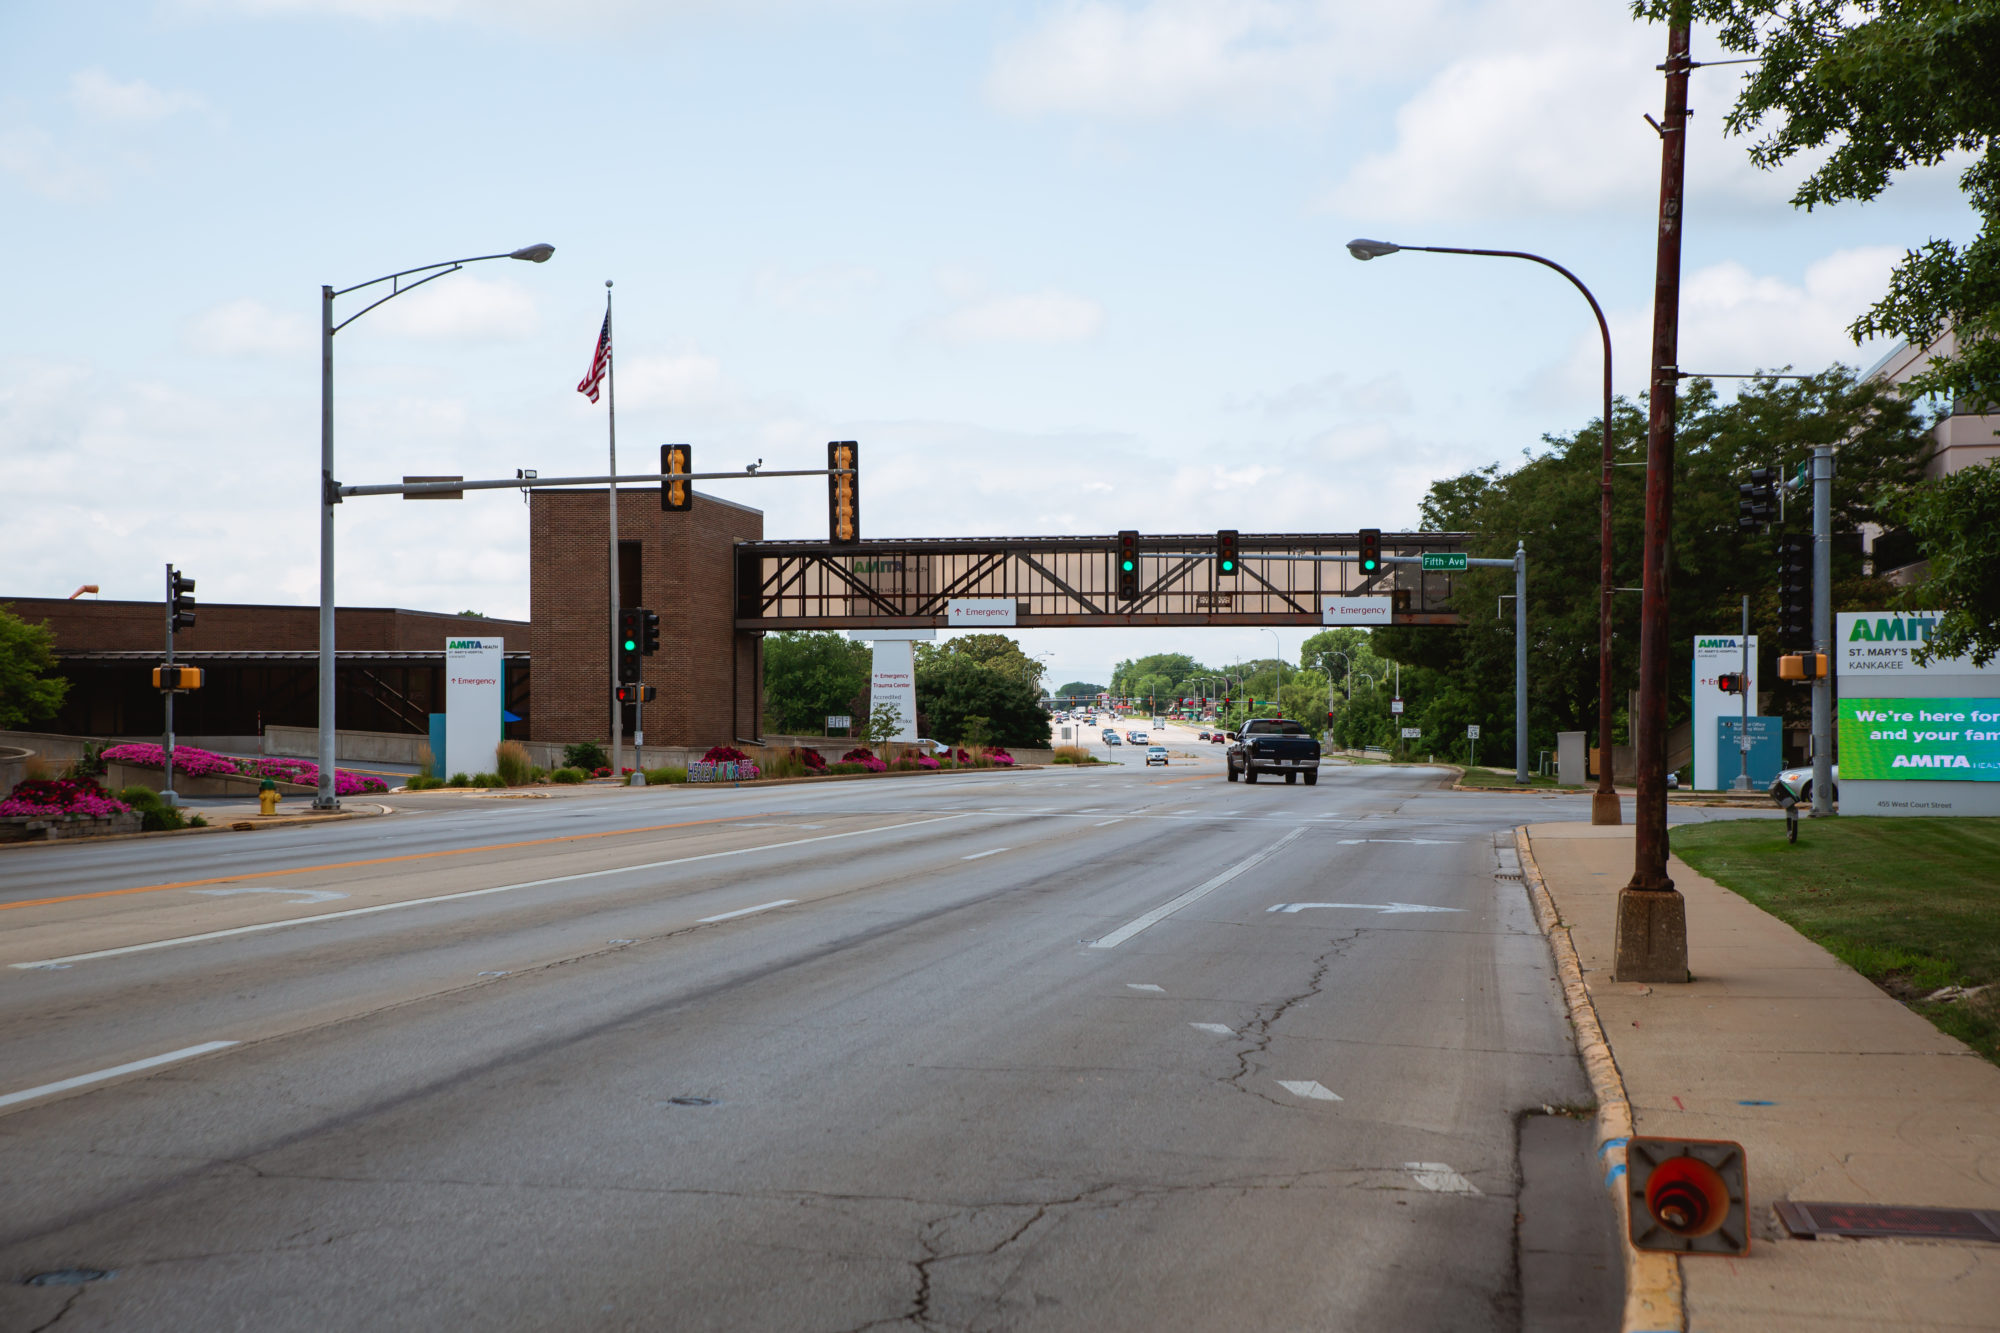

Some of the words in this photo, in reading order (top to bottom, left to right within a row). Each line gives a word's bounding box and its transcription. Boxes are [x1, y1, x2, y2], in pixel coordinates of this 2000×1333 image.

[1424, 557, 1444, 566] Fifth
[1448, 557, 1465, 566] Ave
[965, 608, 1010, 617] Emergency
[1340, 607, 1386, 615] Emergency
[449, 640, 482, 649] AMITA
[1698, 639, 1737, 648] AMITA
[1849, 648, 1865, 656] ST.
[1867, 648, 1908, 656] MARY'S
[1849, 661, 1904, 670] KANKAKEE
[1856, 710, 1914, 722] We're
[1919, 711, 1966, 722] here
[1970, 710, 2000, 723] for
[1870, 729, 1907, 741] and
[1912, 730, 1960, 743] your
[1891, 755, 1971, 768] AMITA
